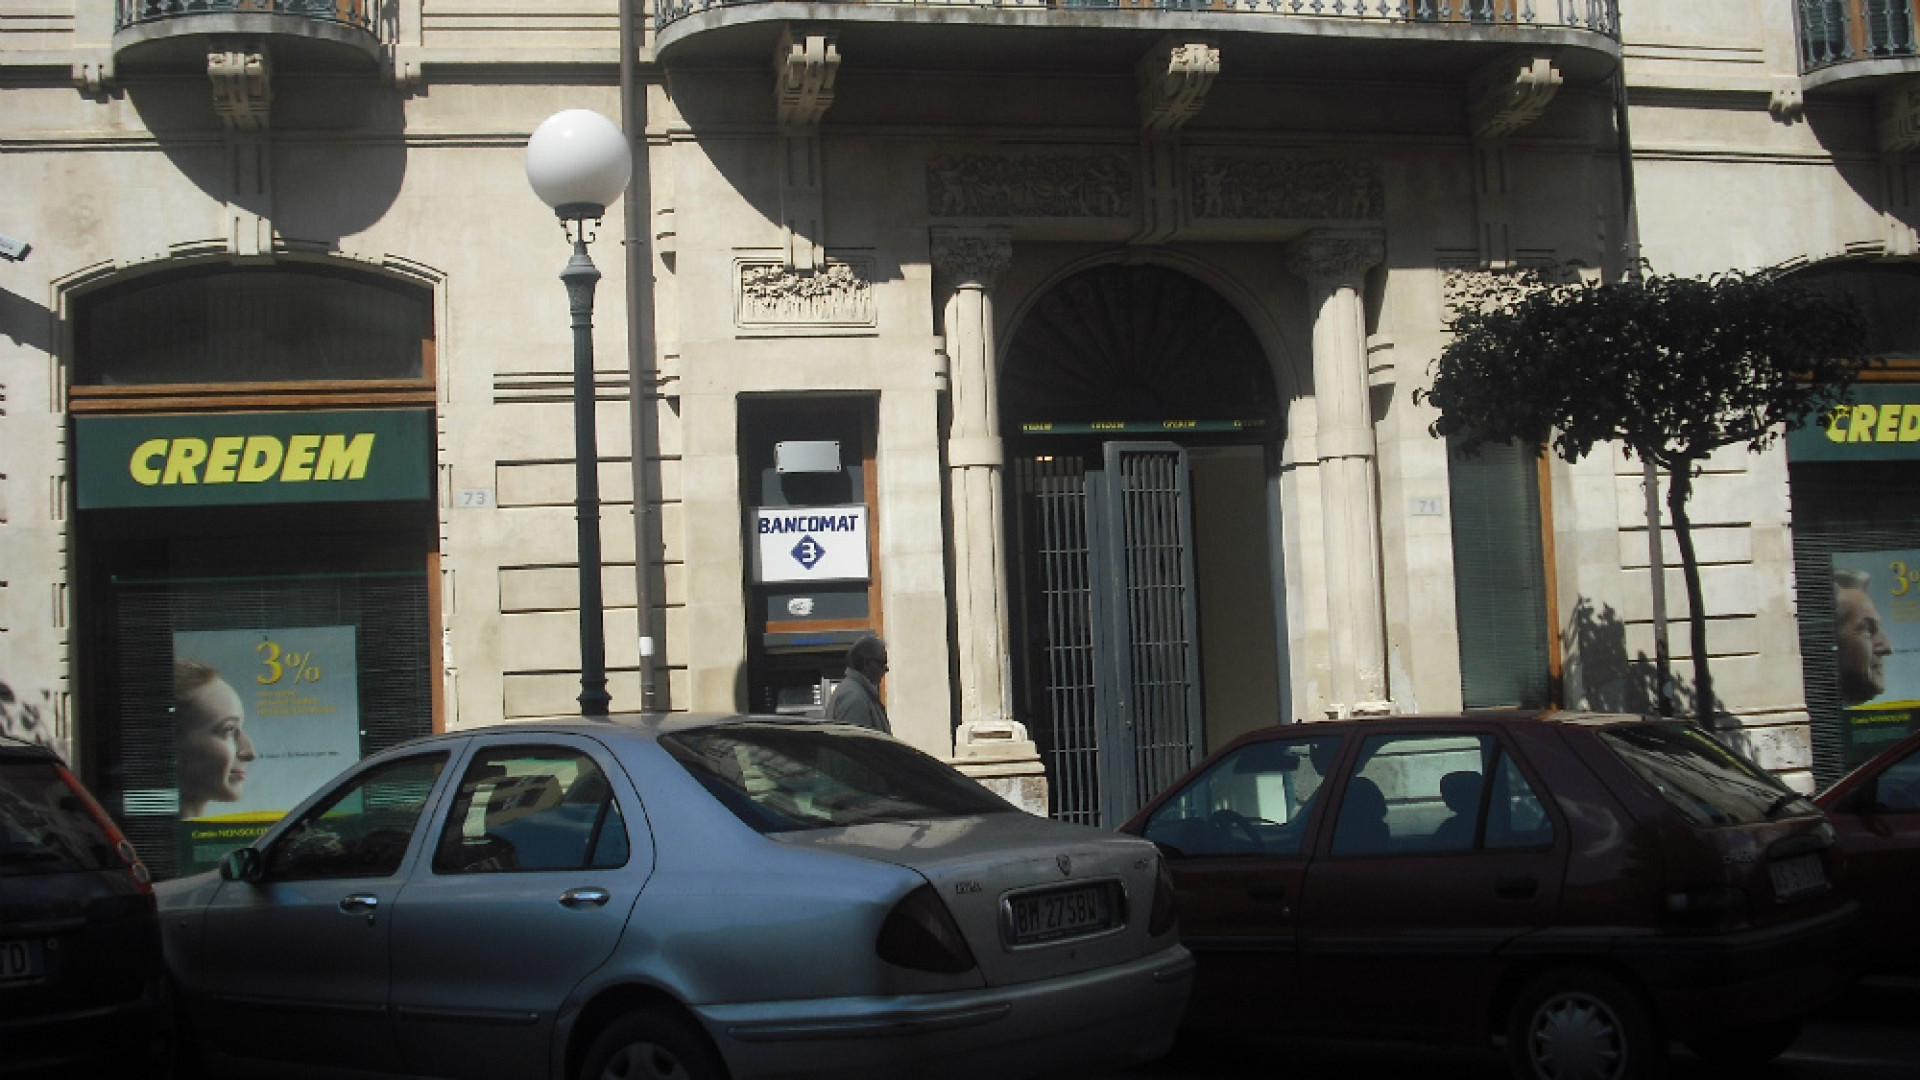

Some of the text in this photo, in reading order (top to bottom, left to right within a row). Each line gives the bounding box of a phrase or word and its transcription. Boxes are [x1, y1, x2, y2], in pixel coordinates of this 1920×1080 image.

[129, 433, 376, 486] CREDEM
[463, 490, 487, 505] 73
[1418, 499, 1435, 513] 71
[757, 514, 859, 534] BANCOMAT
[256, 641, 321, 685] 3%
[1017, 900, 1040, 933] BM
